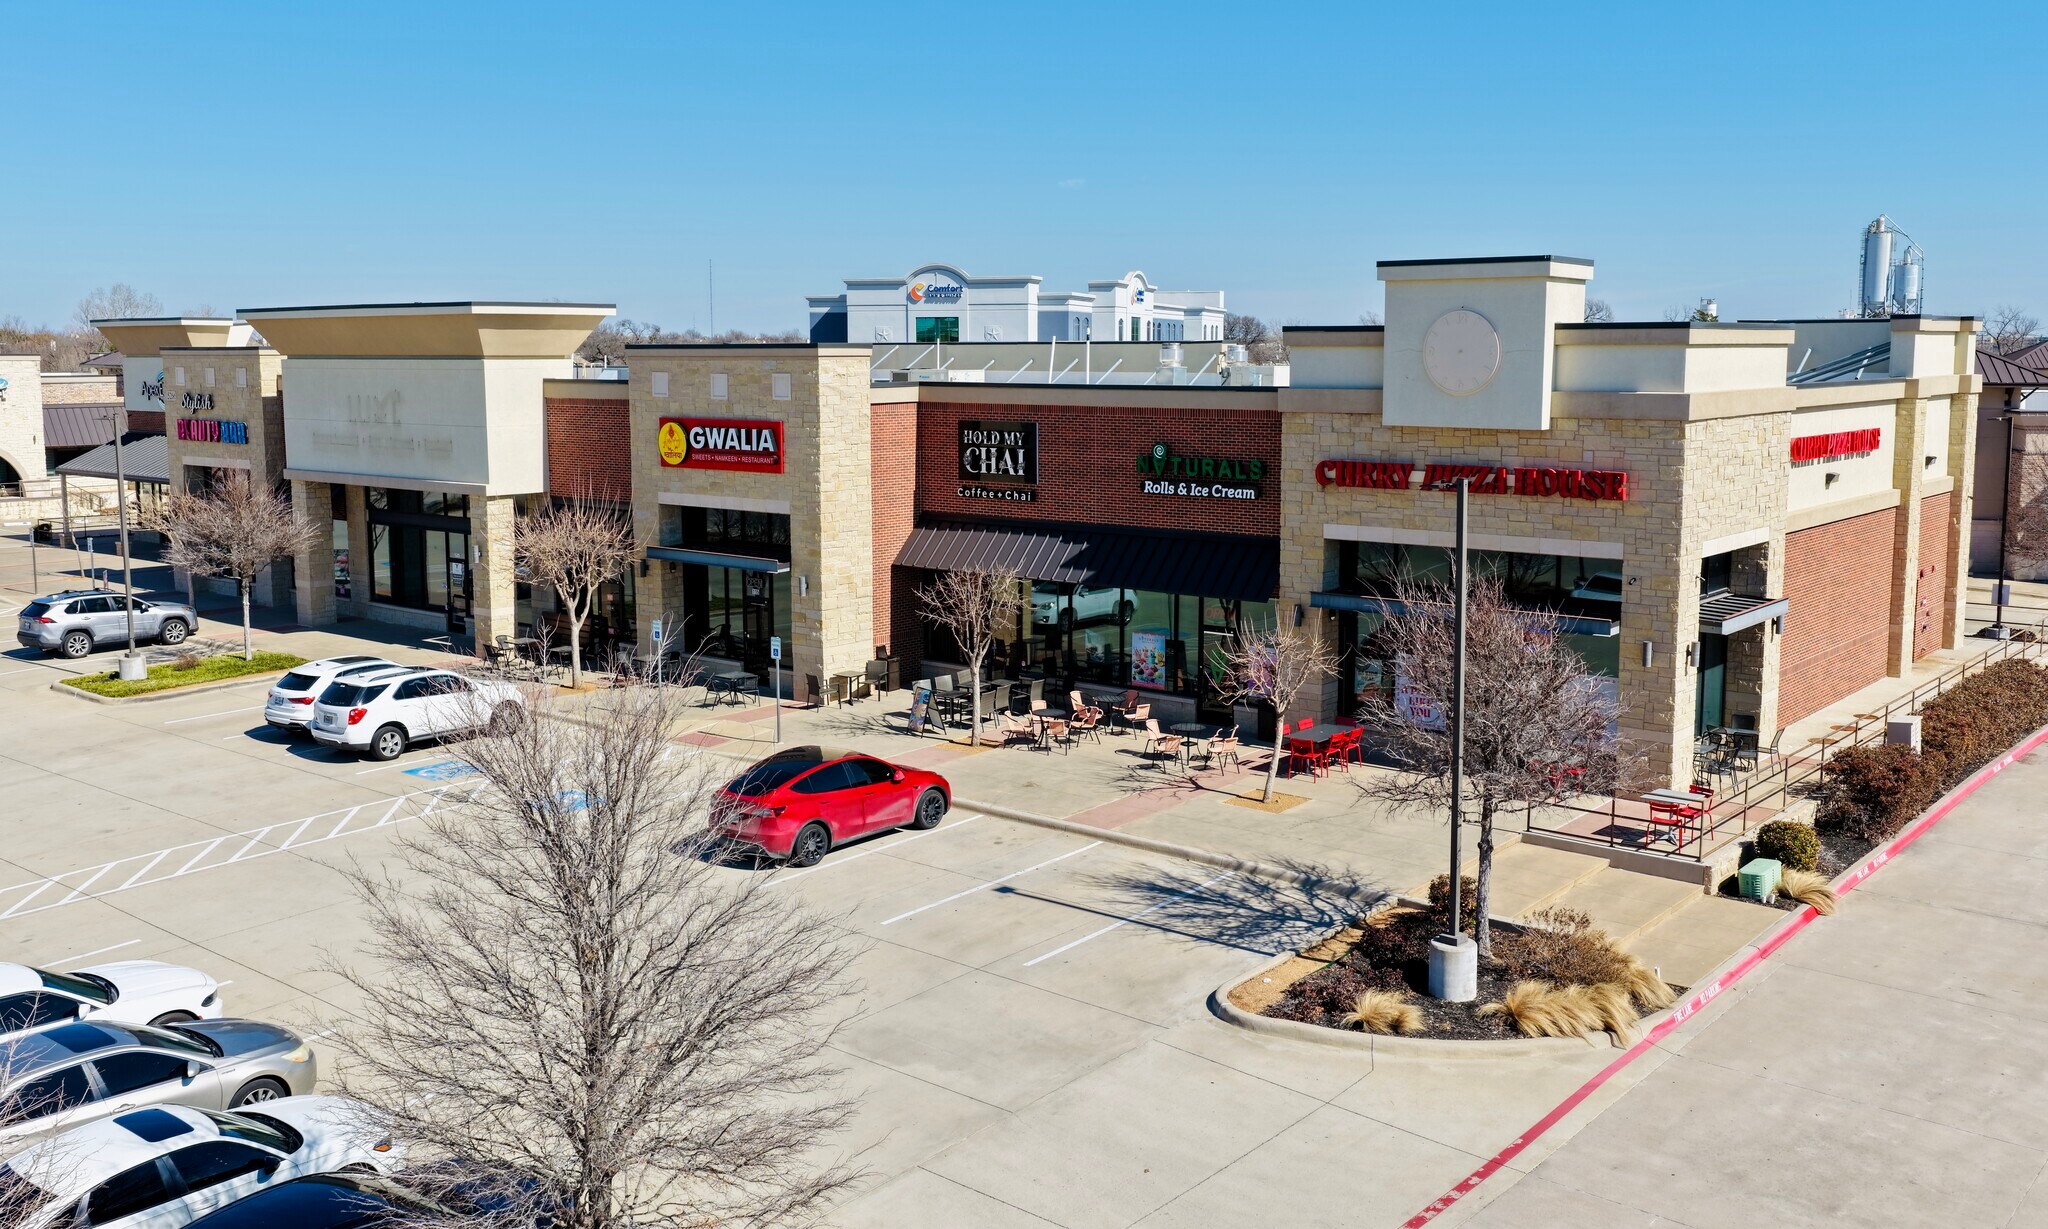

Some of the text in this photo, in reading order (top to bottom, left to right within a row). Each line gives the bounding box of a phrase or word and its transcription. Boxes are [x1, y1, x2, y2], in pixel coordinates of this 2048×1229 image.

[927, 284, 963, 292] Comfort
[181, 392, 214, 414] Stylish
[177, 419, 248, 444] BEAUTY BAR
[689, 426, 776, 452] GWALIA
[964, 430, 1024, 446] HOLD MY
[1790, 427, 1880, 462] CURRY PIZZA HOUSE
[692, 453, 711, 461] SWEETS
[741, 456, 774, 464] RESTAURANT
[963, 447, 1025, 475] CHAI
[1144, 481, 1255, 499] Rolls & Ice Cream
[1315, 459, 1415, 490] CURRY
[1513, 467, 1627, 501] HOUSE
[957, 487, 994, 498] Coffee
[1005, 491, 1031, 501] Chai
[1410, 706, 1431, 718] YOU
